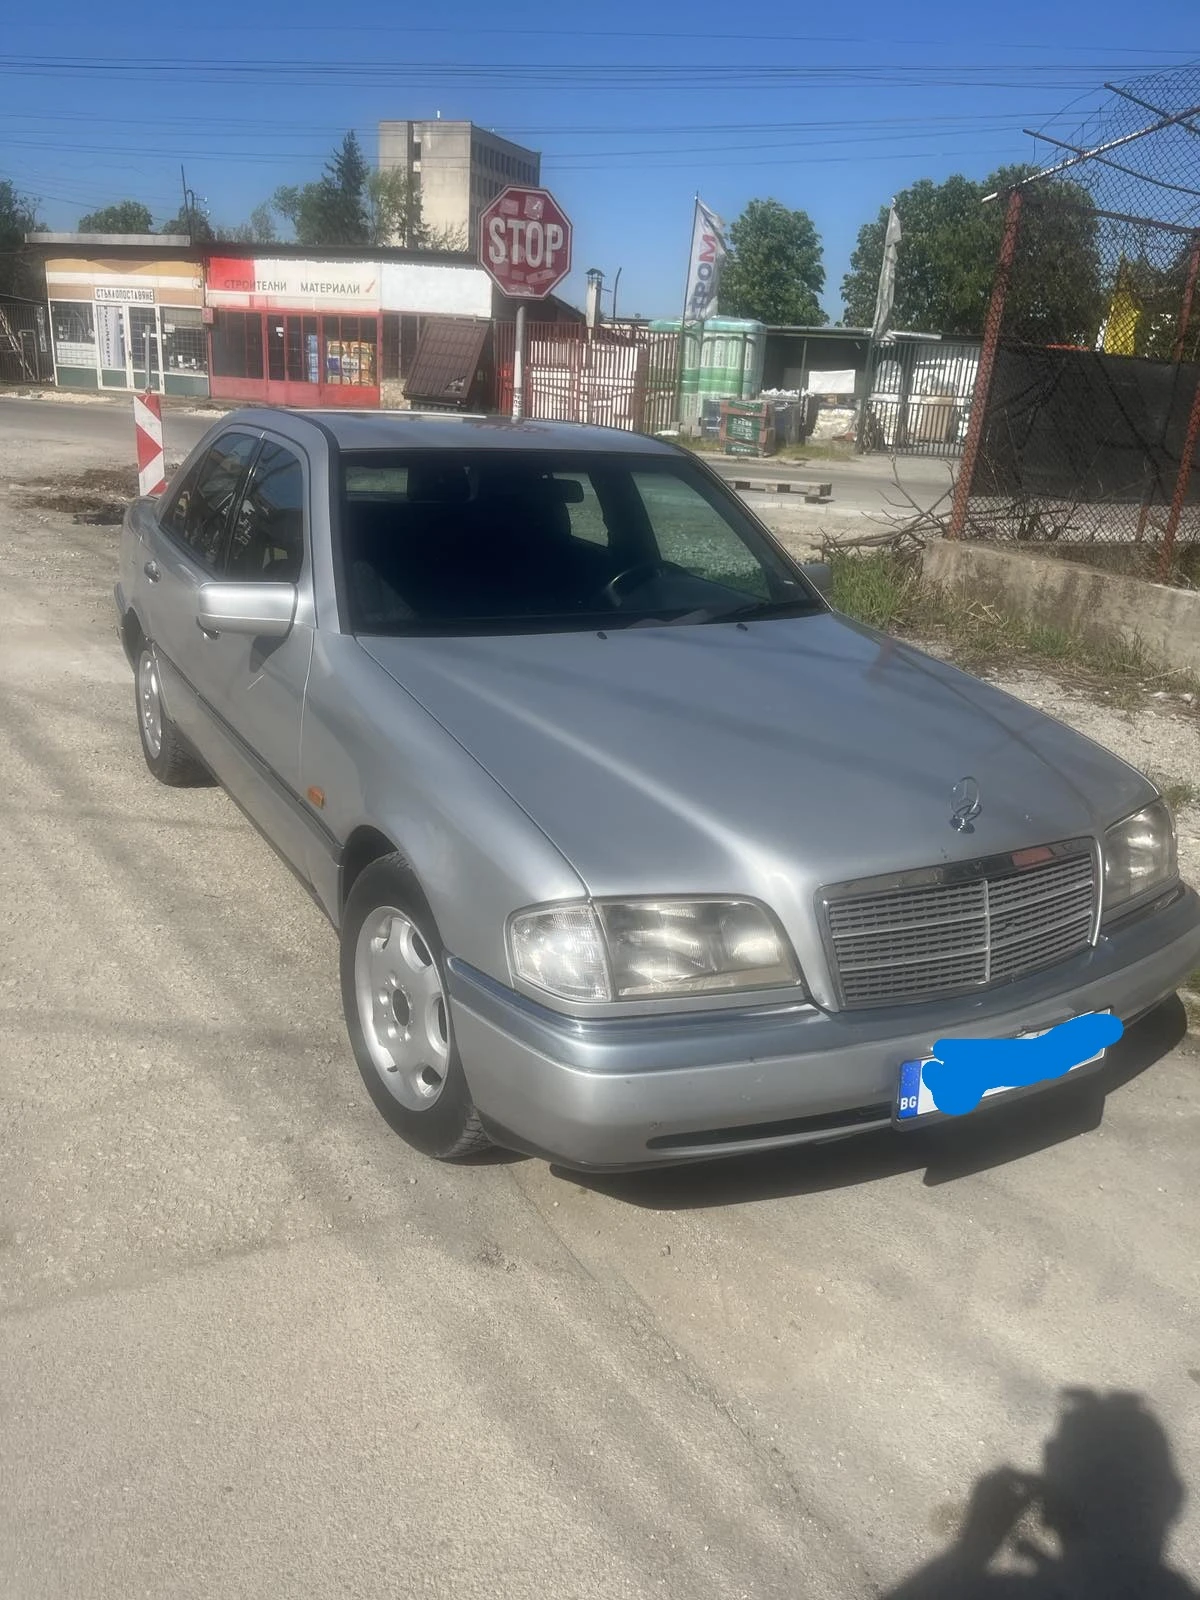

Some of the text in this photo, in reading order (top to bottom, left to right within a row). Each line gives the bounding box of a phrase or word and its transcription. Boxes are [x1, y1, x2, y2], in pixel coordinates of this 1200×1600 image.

[488, 216, 564, 269] STOP
[224, 279, 360, 295] СТРОИТЕЛНИ МАТЕРИАЛИ
[900, 1095, 917, 1110] BG
